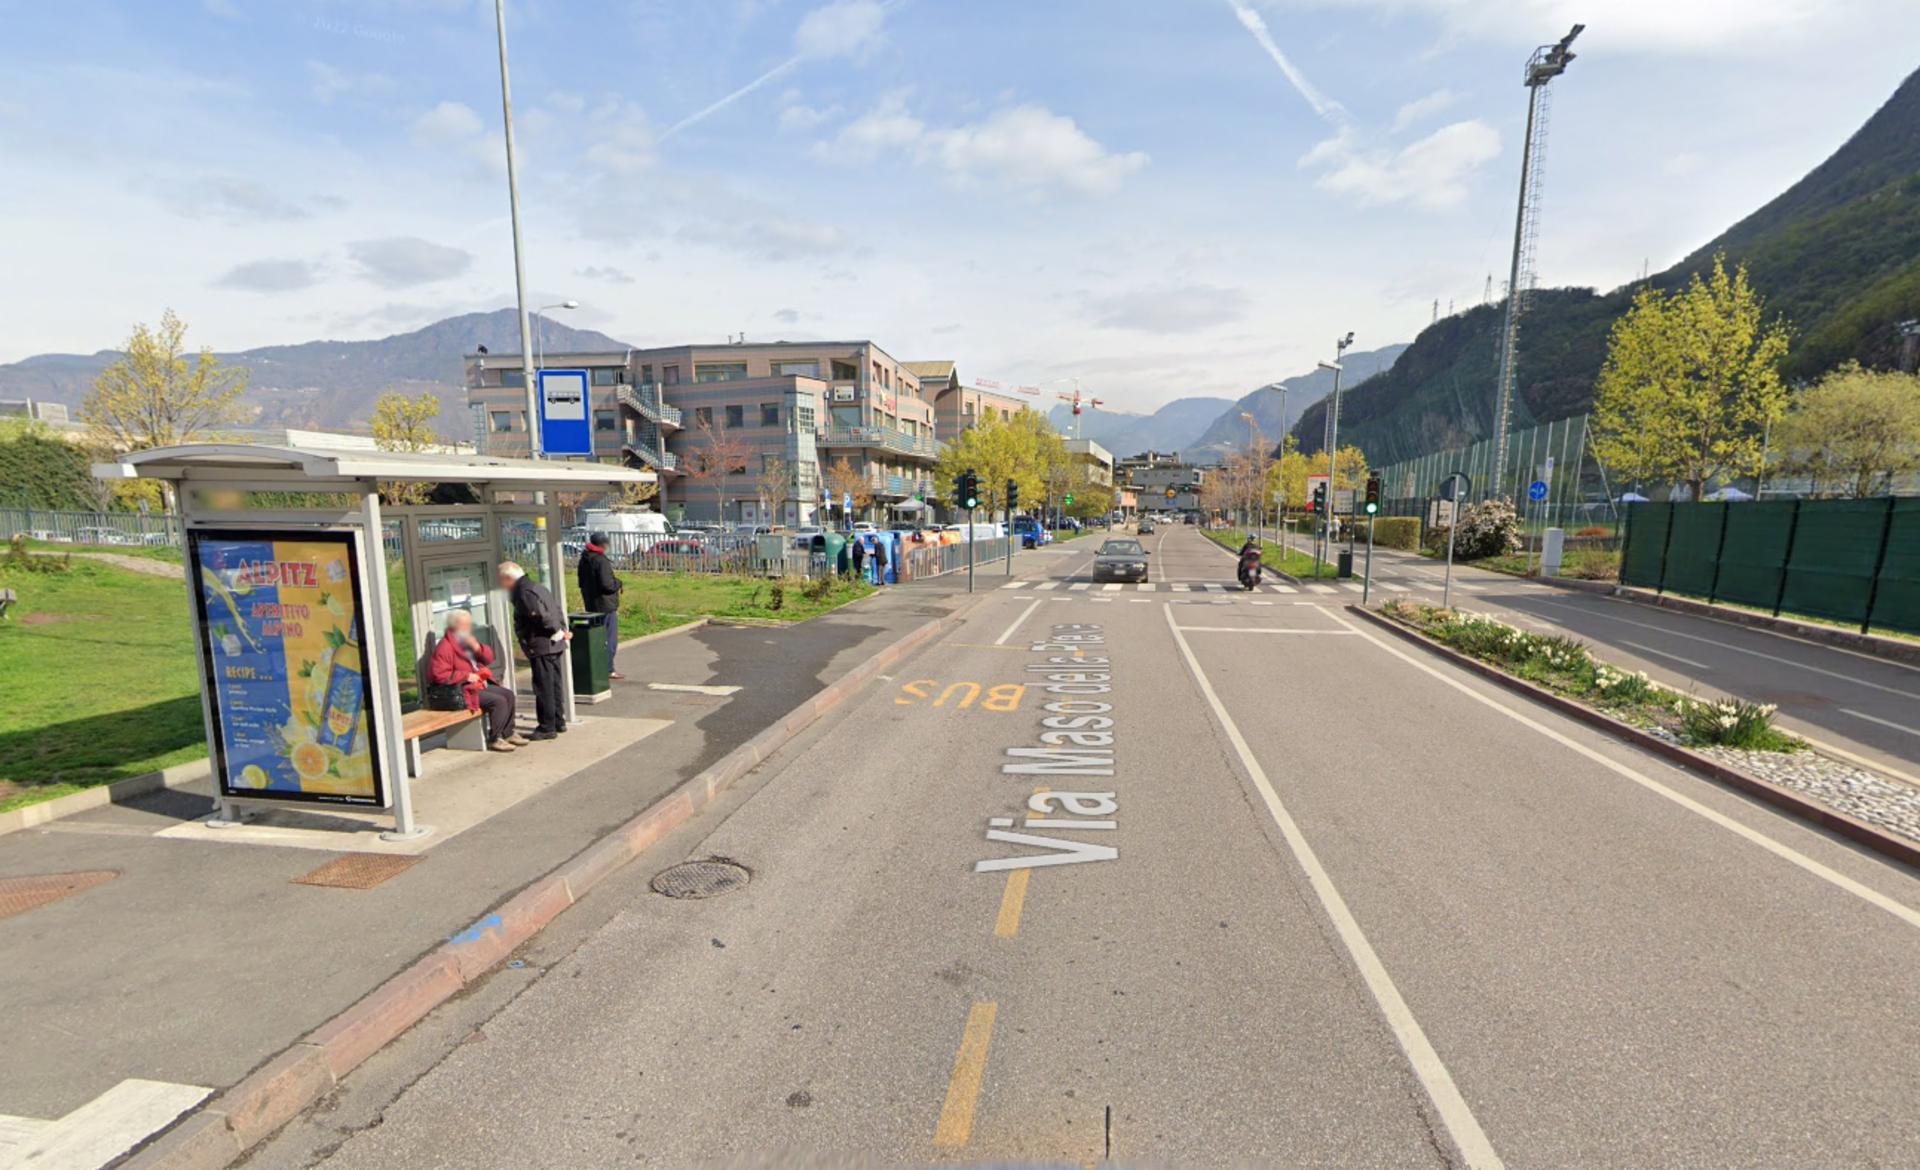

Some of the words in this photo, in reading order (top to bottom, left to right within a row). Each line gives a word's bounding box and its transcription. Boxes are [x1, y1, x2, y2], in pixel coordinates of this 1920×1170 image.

[236, 559, 319, 588] ALPITZ
[251, 602, 310, 619] APERITIVO
[262, 620, 304, 639] ALPINO
[225, 666, 256, 680] RECIPE
[895, 679, 1026, 712] BUS
